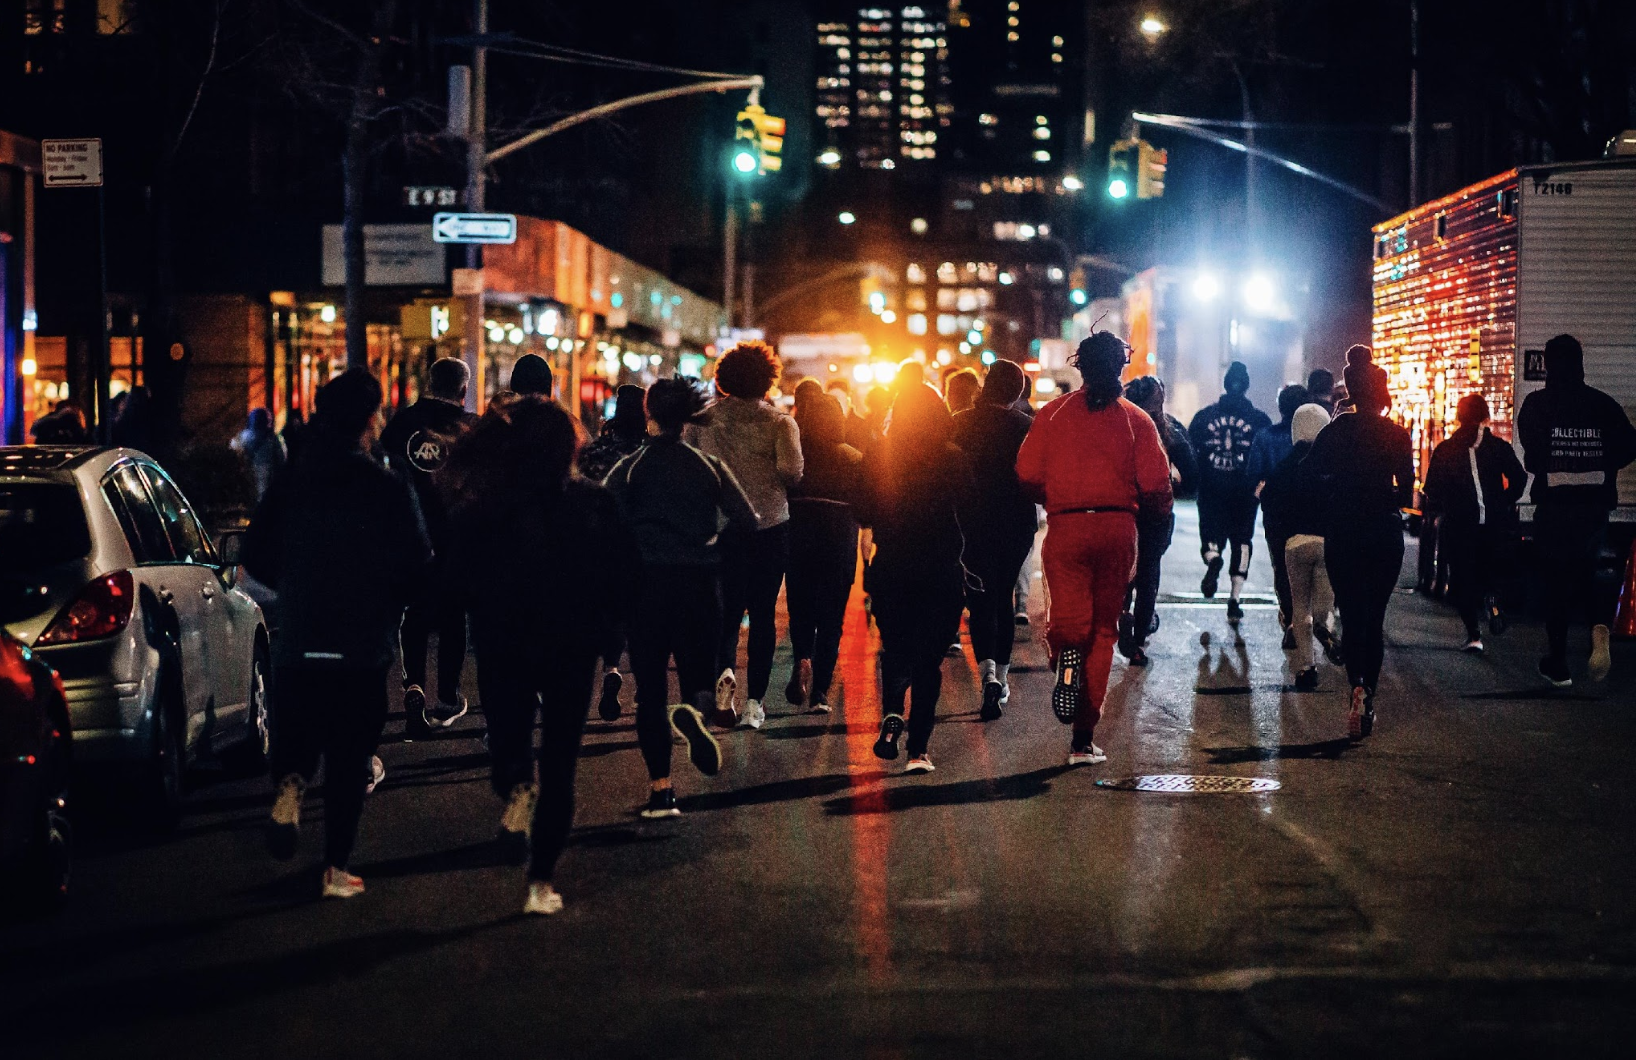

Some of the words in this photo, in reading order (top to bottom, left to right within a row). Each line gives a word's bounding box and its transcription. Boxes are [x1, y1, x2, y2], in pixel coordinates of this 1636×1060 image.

[46, 144, 56, 152] NO
[58, 143, 88, 152] PARKING
[1551, 427, 1602, 438] COLLECTIBLE
